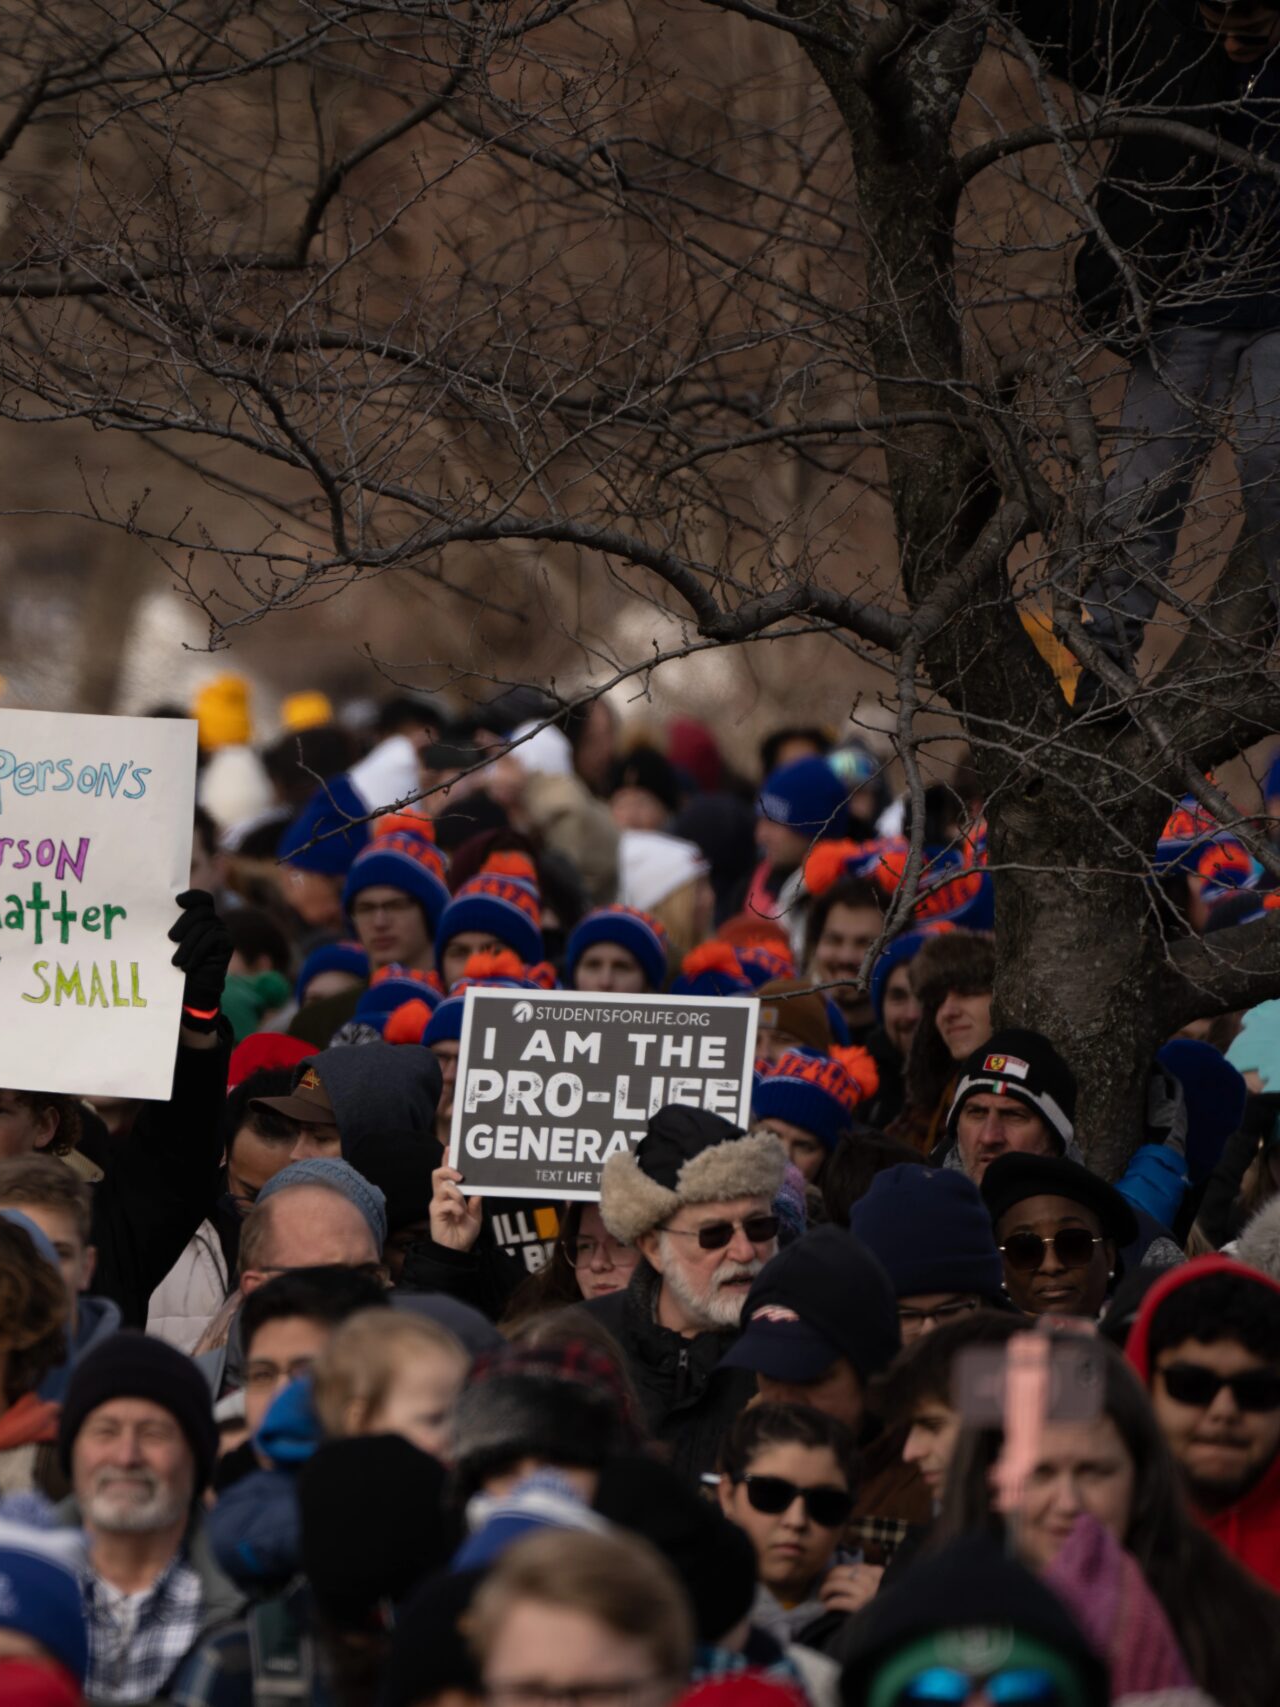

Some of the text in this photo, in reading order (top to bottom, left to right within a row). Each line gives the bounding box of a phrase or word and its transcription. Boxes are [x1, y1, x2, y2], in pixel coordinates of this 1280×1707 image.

[21, 960, 148, 1009] SMALL
[535, 1006, 711, 1027] STUDENTSFORLIFE.ORG
[483, 1027, 728, 1069] I AM THE
[464, 1068, 740, 1125] PRO-LIFE
[535, 1170, 564, 1184] TEXT
[566, 1171, 592, 1184] LIFE
